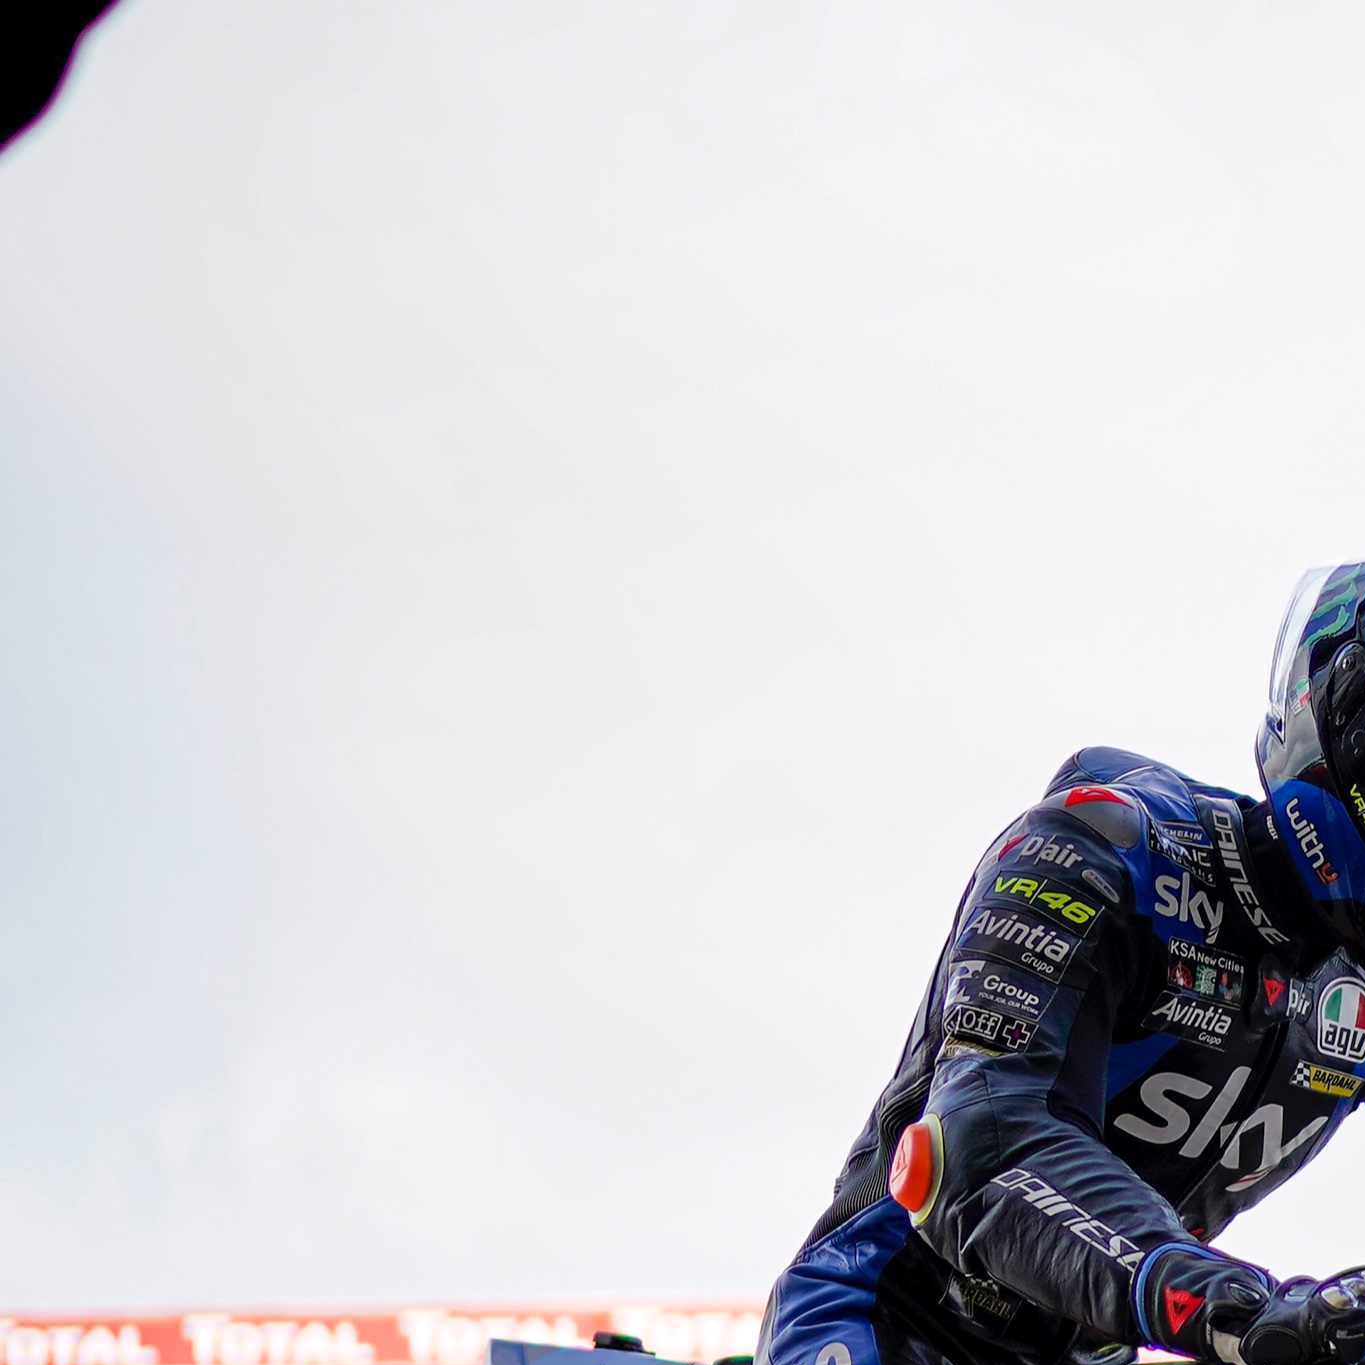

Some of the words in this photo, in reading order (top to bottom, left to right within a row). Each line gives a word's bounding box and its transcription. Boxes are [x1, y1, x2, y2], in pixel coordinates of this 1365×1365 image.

[1286, 797, 1339, 885] withu
[1212, 808, 1290, 945] DAINESE
[1155, 872, 1224, 944] sky
[964, 910, 1071, 963] Avintia
[1021, 952, 1054, 974] Grupo
[1171, 939, 1196, 961] KSA
[1197, 952, 1217, 966] New
[1218, 958, 1245, 973] Cities
[983, 975, 1040, 1005] Group
[963, 1010, 998, 1034] Off
[1152, 997, 1232, 1035] Avintia
[1198, 1031, 1222, 1045] Grupo
[1312, 1069, 1356, 1091] BARDAHL
[1113, 1066, 1329, 1192] sky
